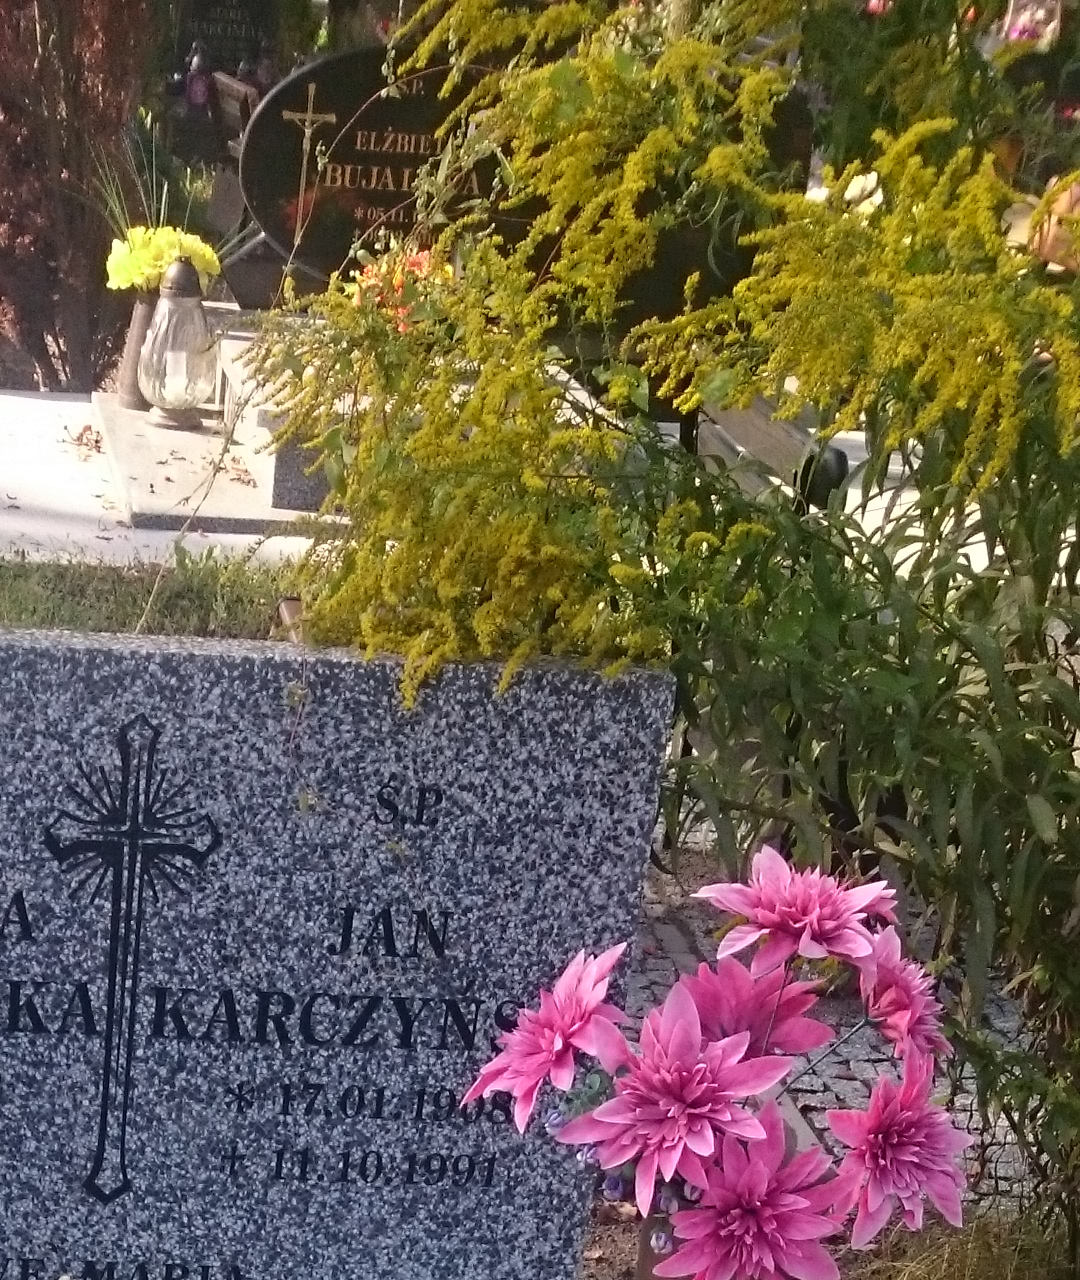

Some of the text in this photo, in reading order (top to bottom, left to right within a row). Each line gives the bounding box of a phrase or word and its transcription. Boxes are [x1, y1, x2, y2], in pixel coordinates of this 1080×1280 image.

[355, 126, 450, 156] ELŻBIET
[326, 901, 454, 958] JAN
[146, 978, 526, 1055] KARCZYŃS
[273, 1148, 499, 1188] 11.10.1991
